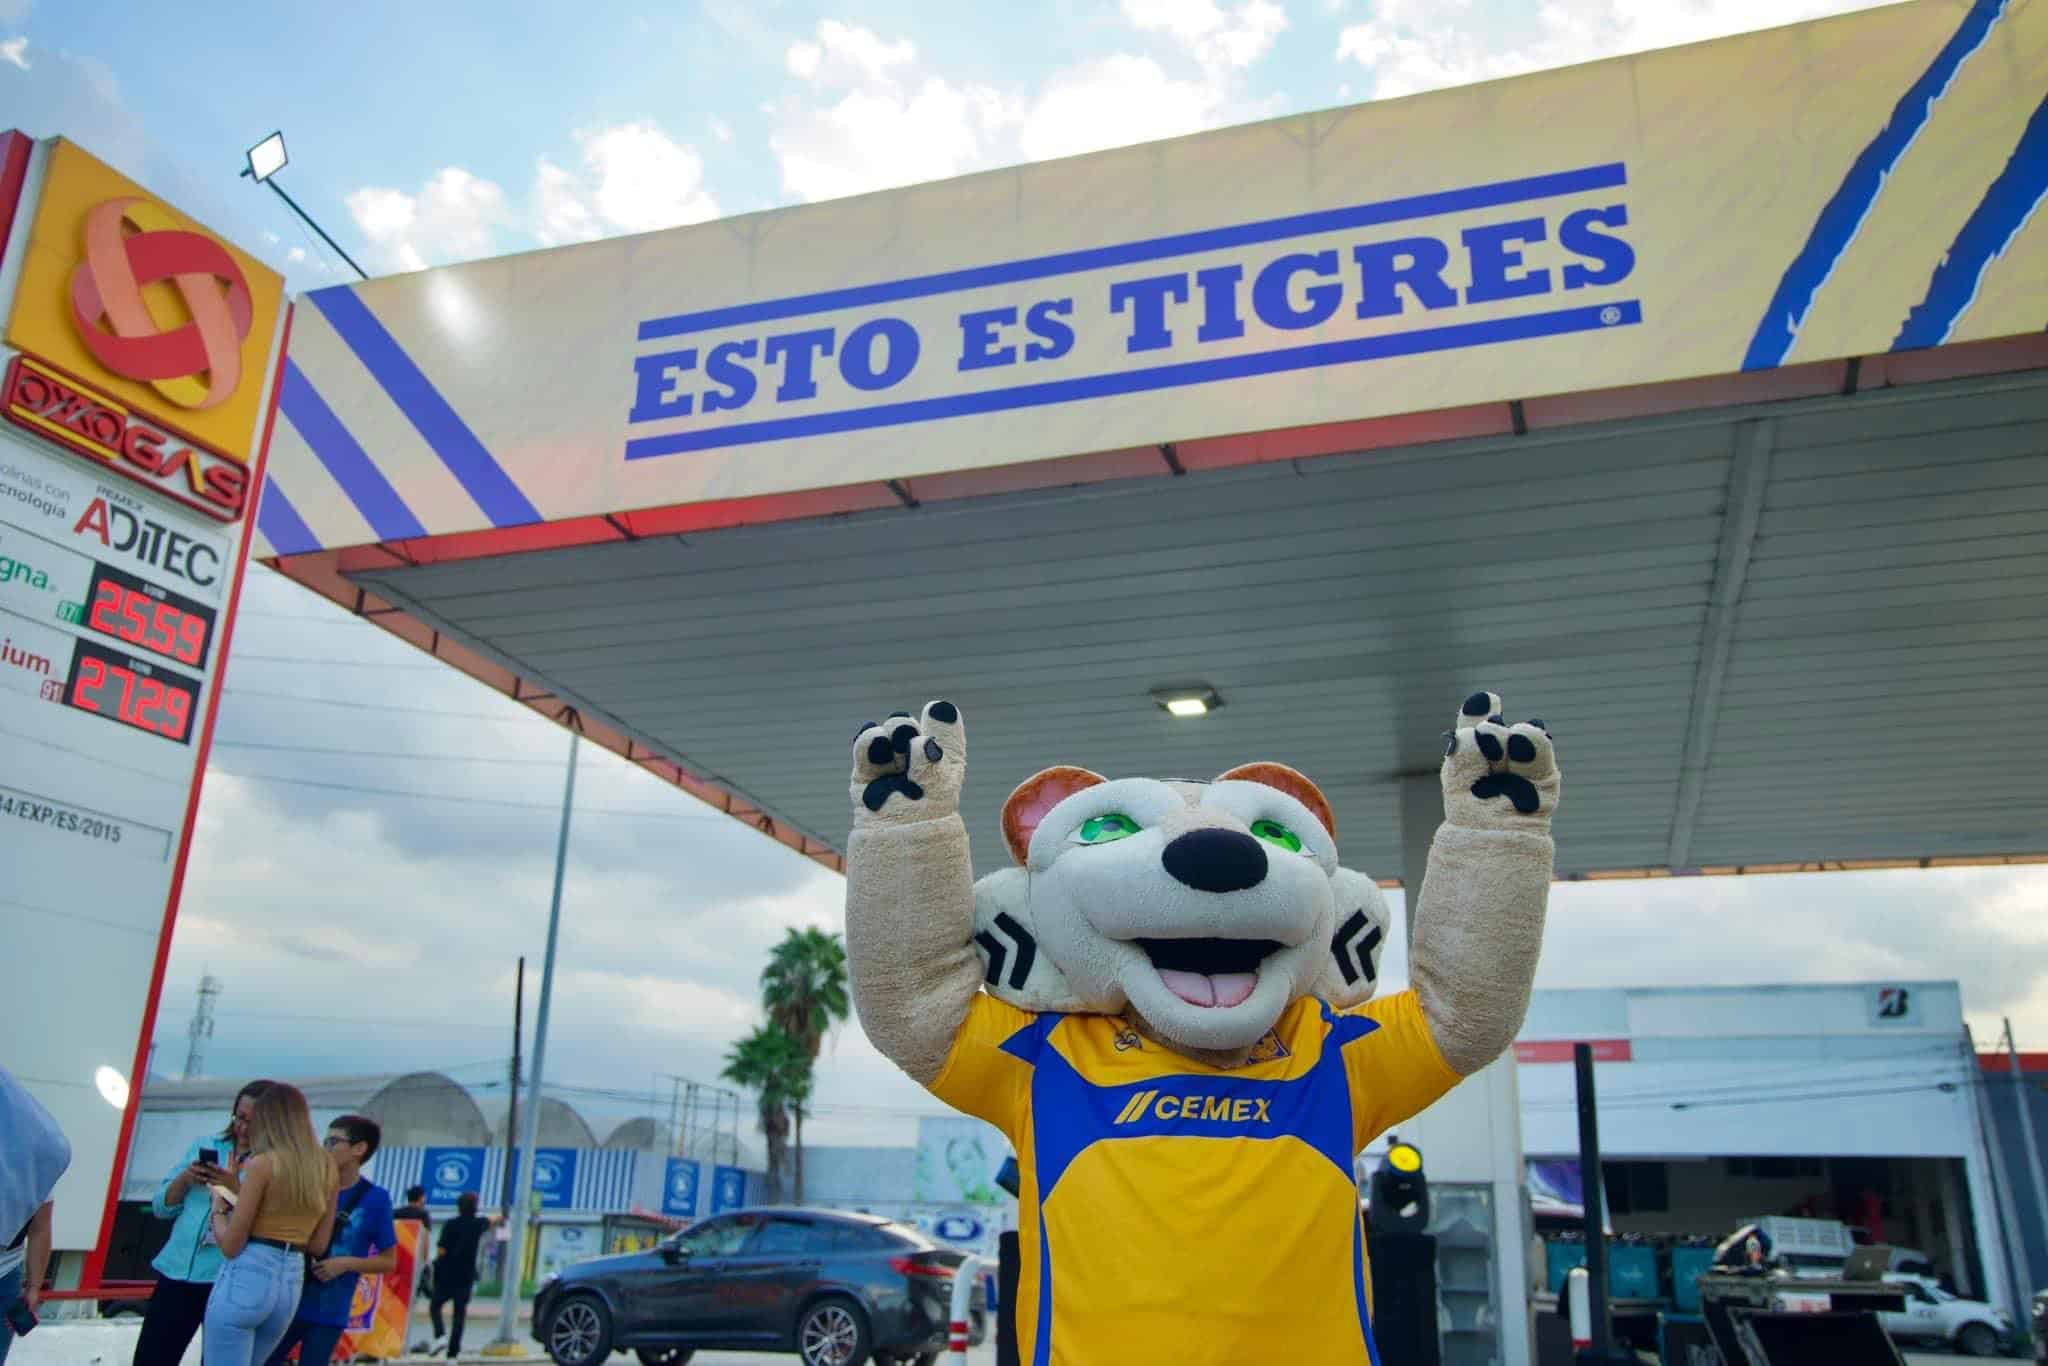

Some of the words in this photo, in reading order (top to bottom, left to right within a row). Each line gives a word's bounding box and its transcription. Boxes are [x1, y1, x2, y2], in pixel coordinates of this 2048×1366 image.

[627, 317, 921, 424] ESTO
[957, 298, 1077, 373] ES
[1109, 203, 1637, 353] TIGRES
[1154, 1095, 1271, 1123] CEMEX
